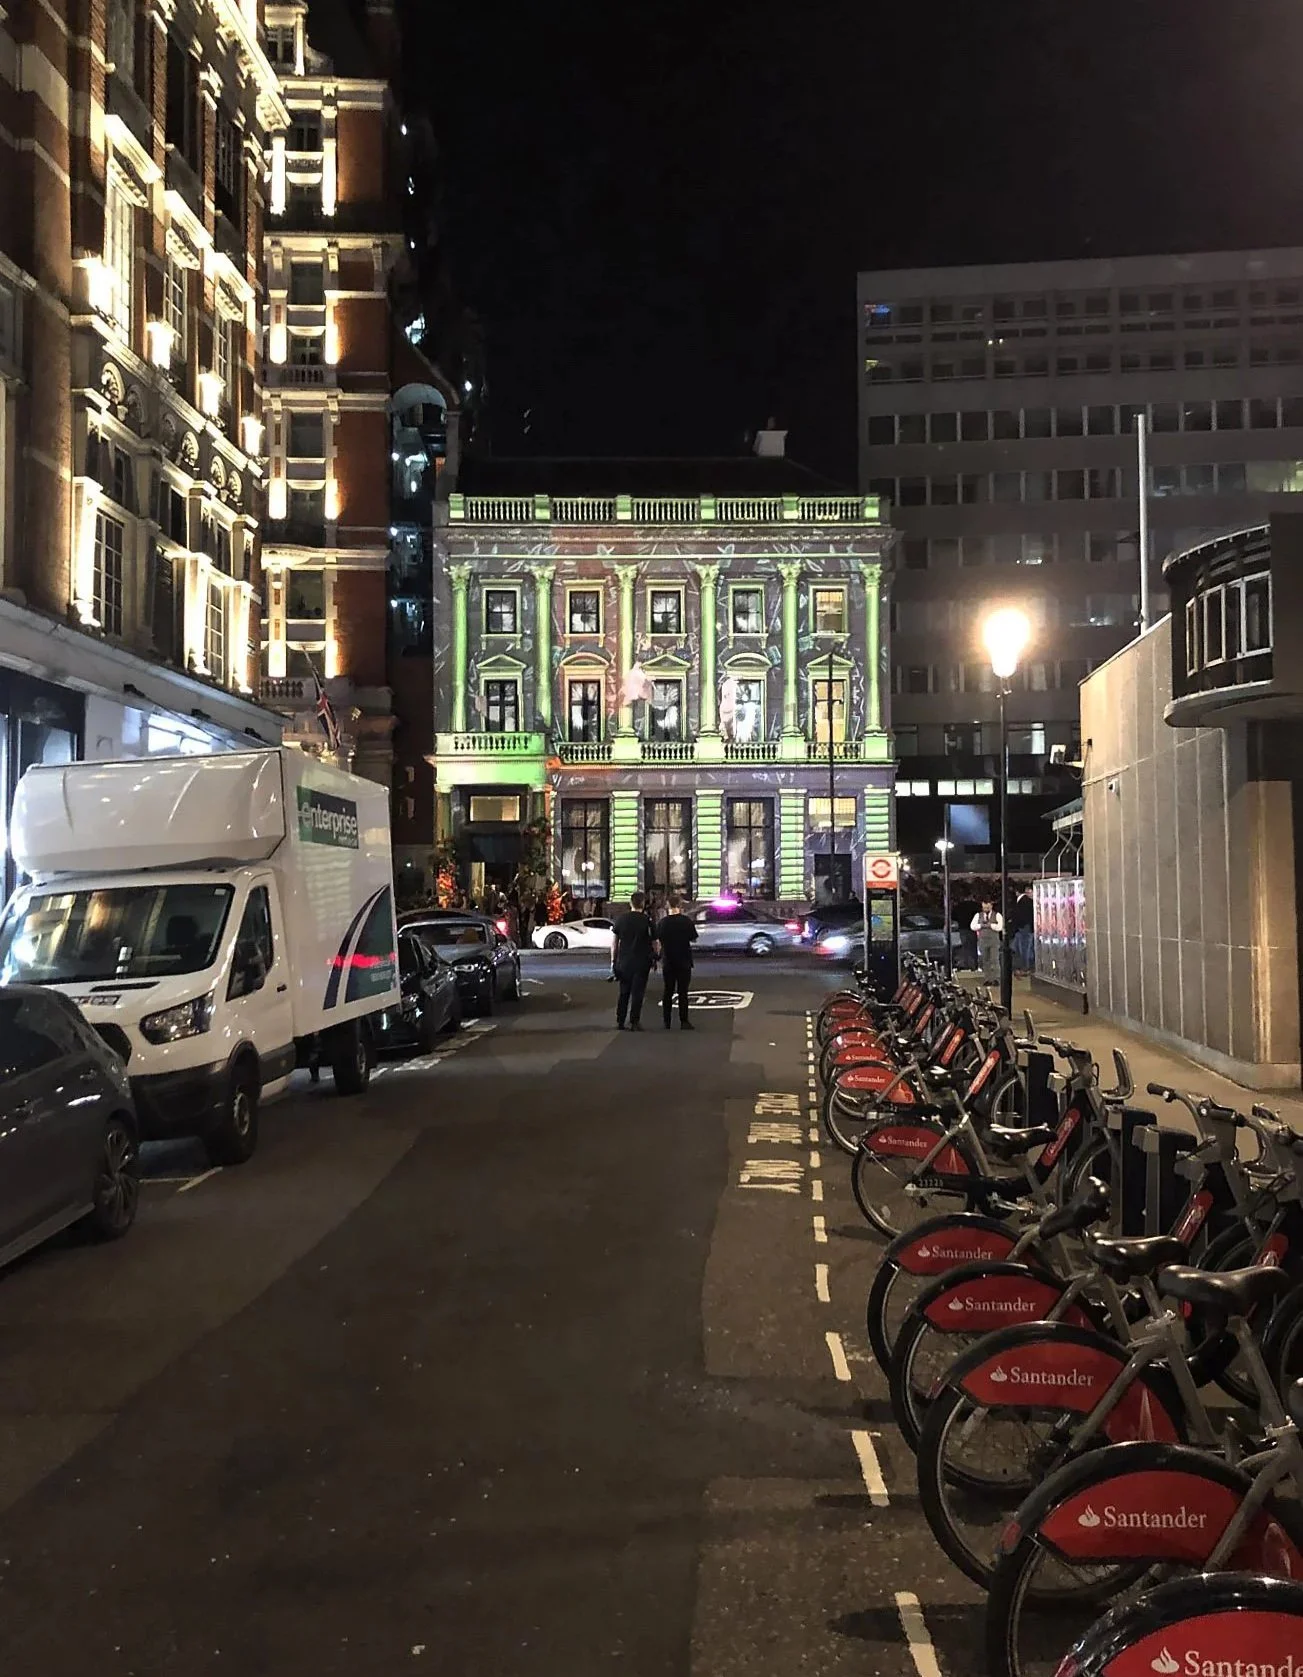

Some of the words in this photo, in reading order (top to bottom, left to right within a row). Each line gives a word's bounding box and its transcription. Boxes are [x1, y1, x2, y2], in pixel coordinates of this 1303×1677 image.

[299, 802, 357, 839] enterprise
[854, 1074, 886, 1083] Santander
[747, 1122, 804, 1144] HIRE
[887, 1135, 928, 1148] Santander
[738, 1160, 805, 1193] ONLY
[931, 1244, 993, 1260] Santander
[965, 1296, 1036, 1312] Santander
[1010, 1366, 1095, 1386] Santander
[1104, 1505, 1207, 1528] Santander
